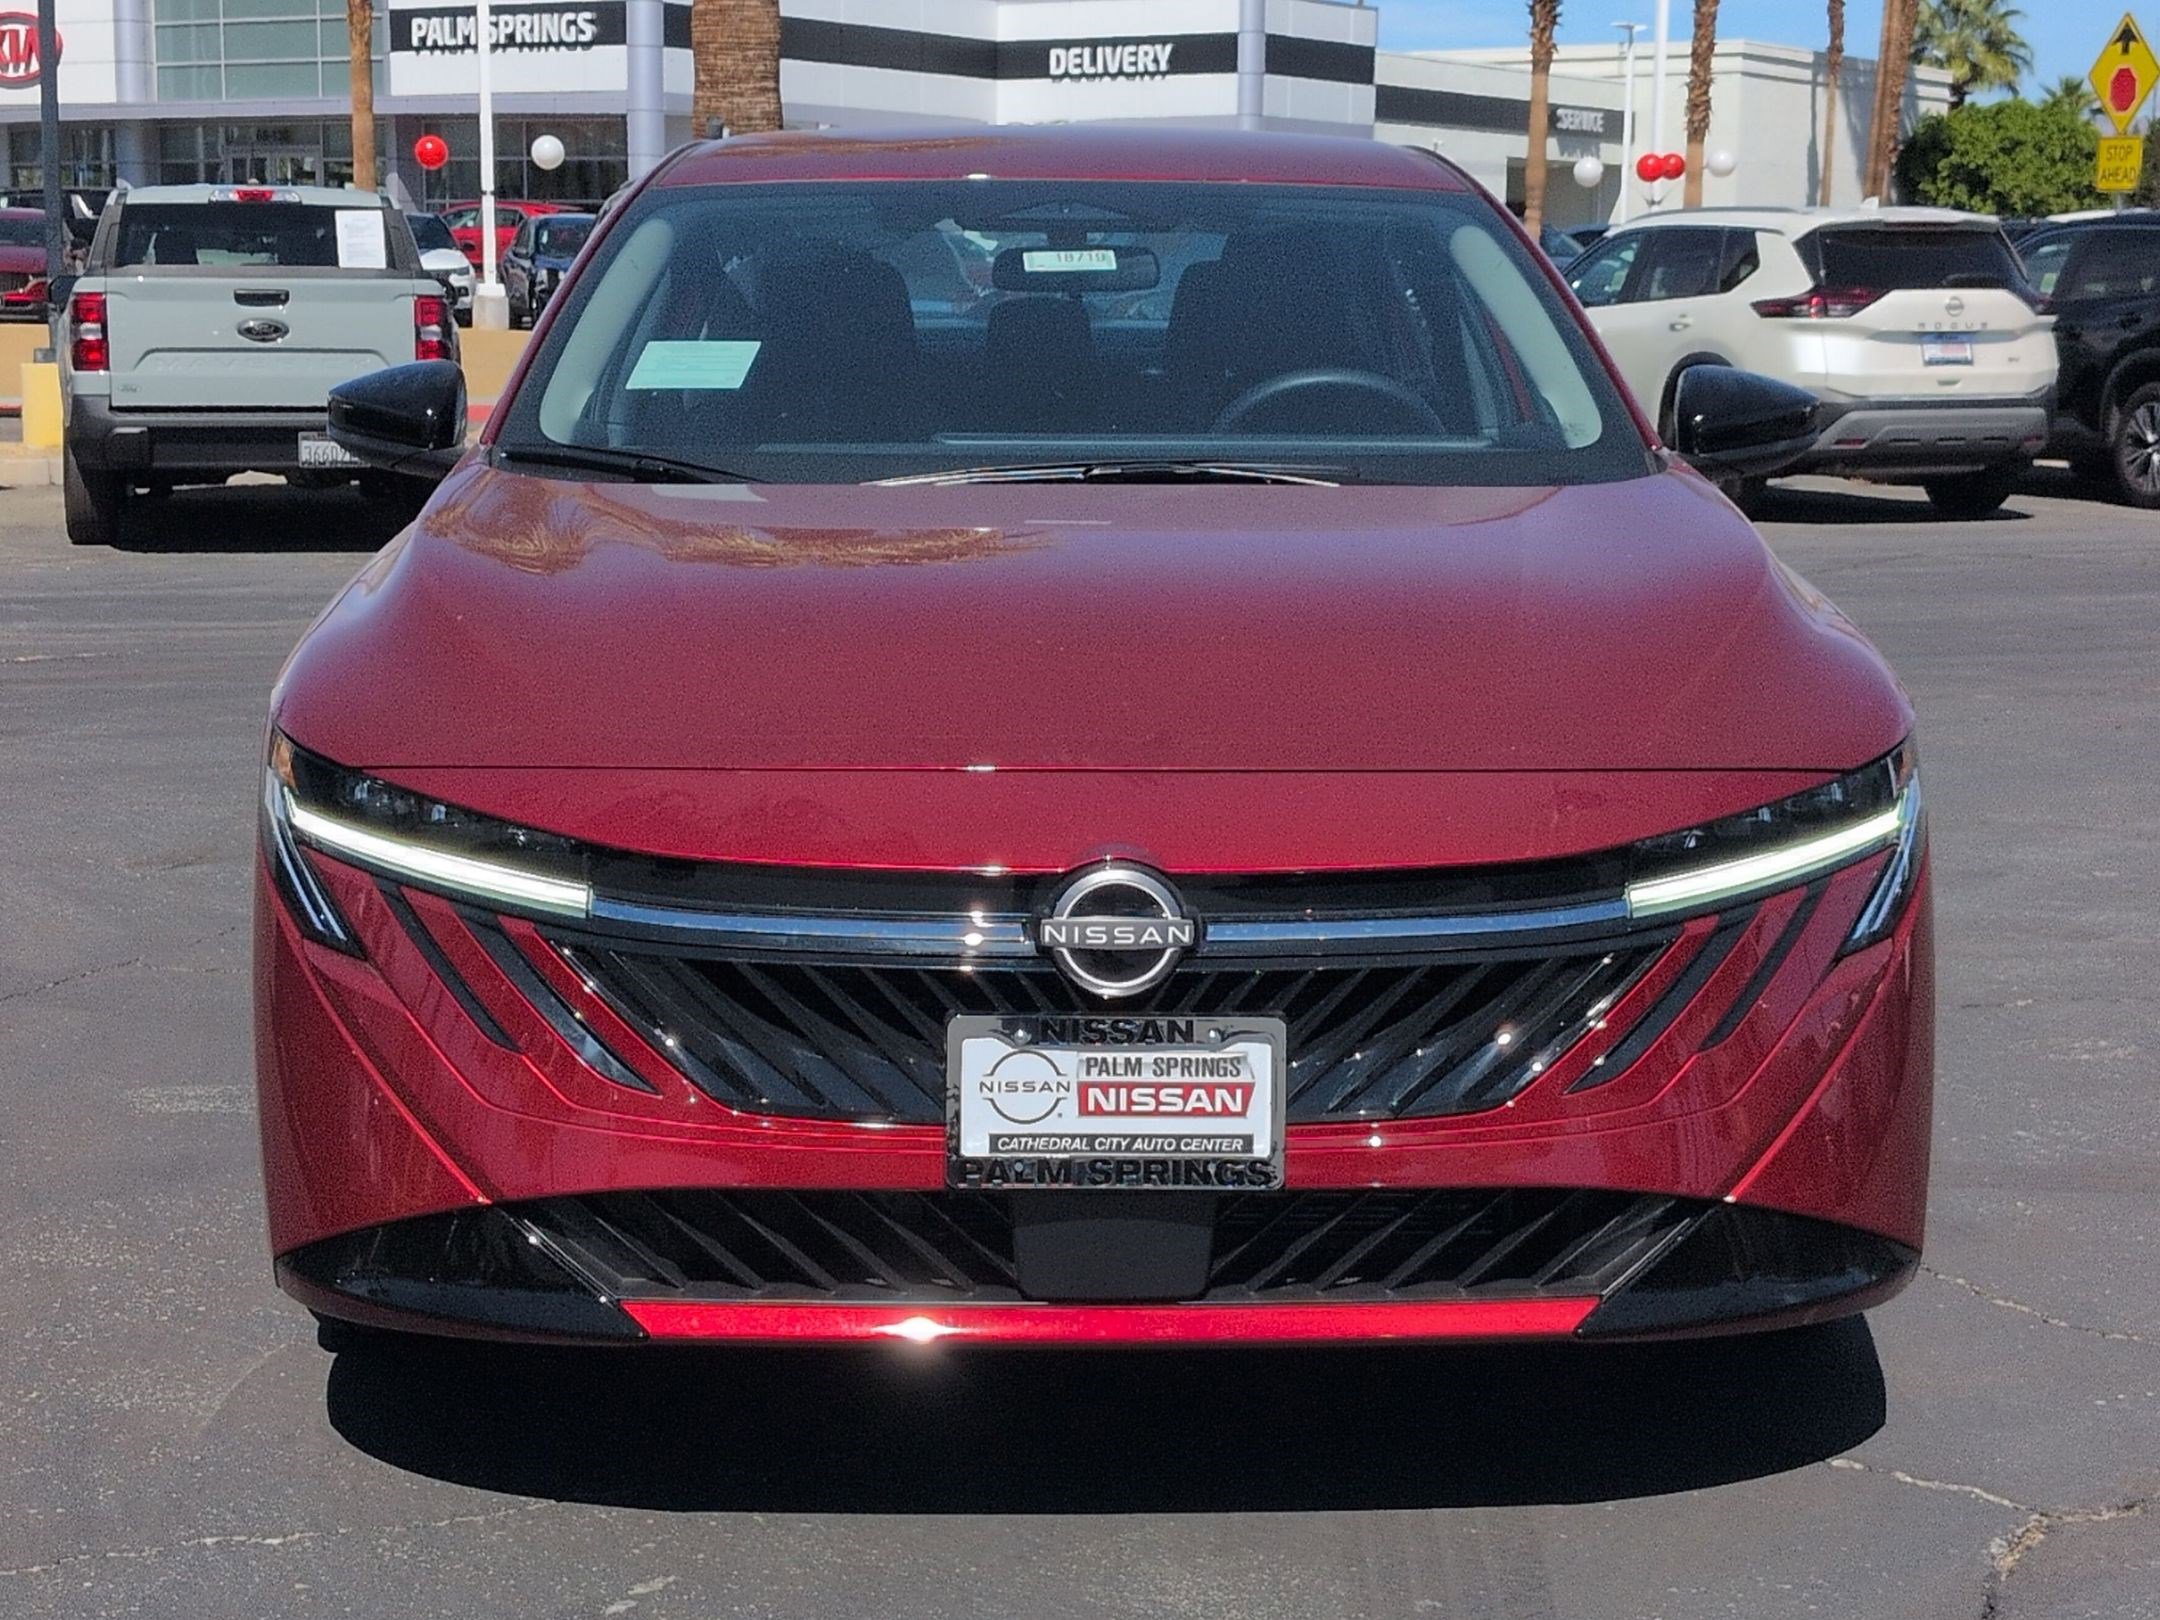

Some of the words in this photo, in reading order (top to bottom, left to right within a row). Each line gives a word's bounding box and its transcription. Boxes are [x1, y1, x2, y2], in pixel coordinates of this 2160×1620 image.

[411, 16, 478, 47] PALM
[489, 12, 597, 44] SPRINGS
[1049, 43, 1173, 75] DELIVERY
[1556, 108, 1604, 132] SERVICE
[2106, 144, 2133, 162] STOP
[2101, 166, 2137, 183] AHEAD
[1044, 925, 1190, 945] NISSAN
[1041, 1019, 1195, 1044] NISSAN
[1085, 1057, 1142, 1078] PALM
[1153, 1056, 1242, 1078] SPRINGS
[979, 1081, 1071, 1093] NISSAN
[1087, 1088, 1243, 1113] NISSAN
[998, 1138, 1092, 1151] CATHEDRAL
[1094, 1137, 1130, 1151] CITY
[1133, 1137, 1177, 1151] AUTO
[1180, 1138, 1244, 1151] CENTER
[958, 1159, 1072, 1186] PALM
[1086, 1159, 1273, 1187] SPRINGS
